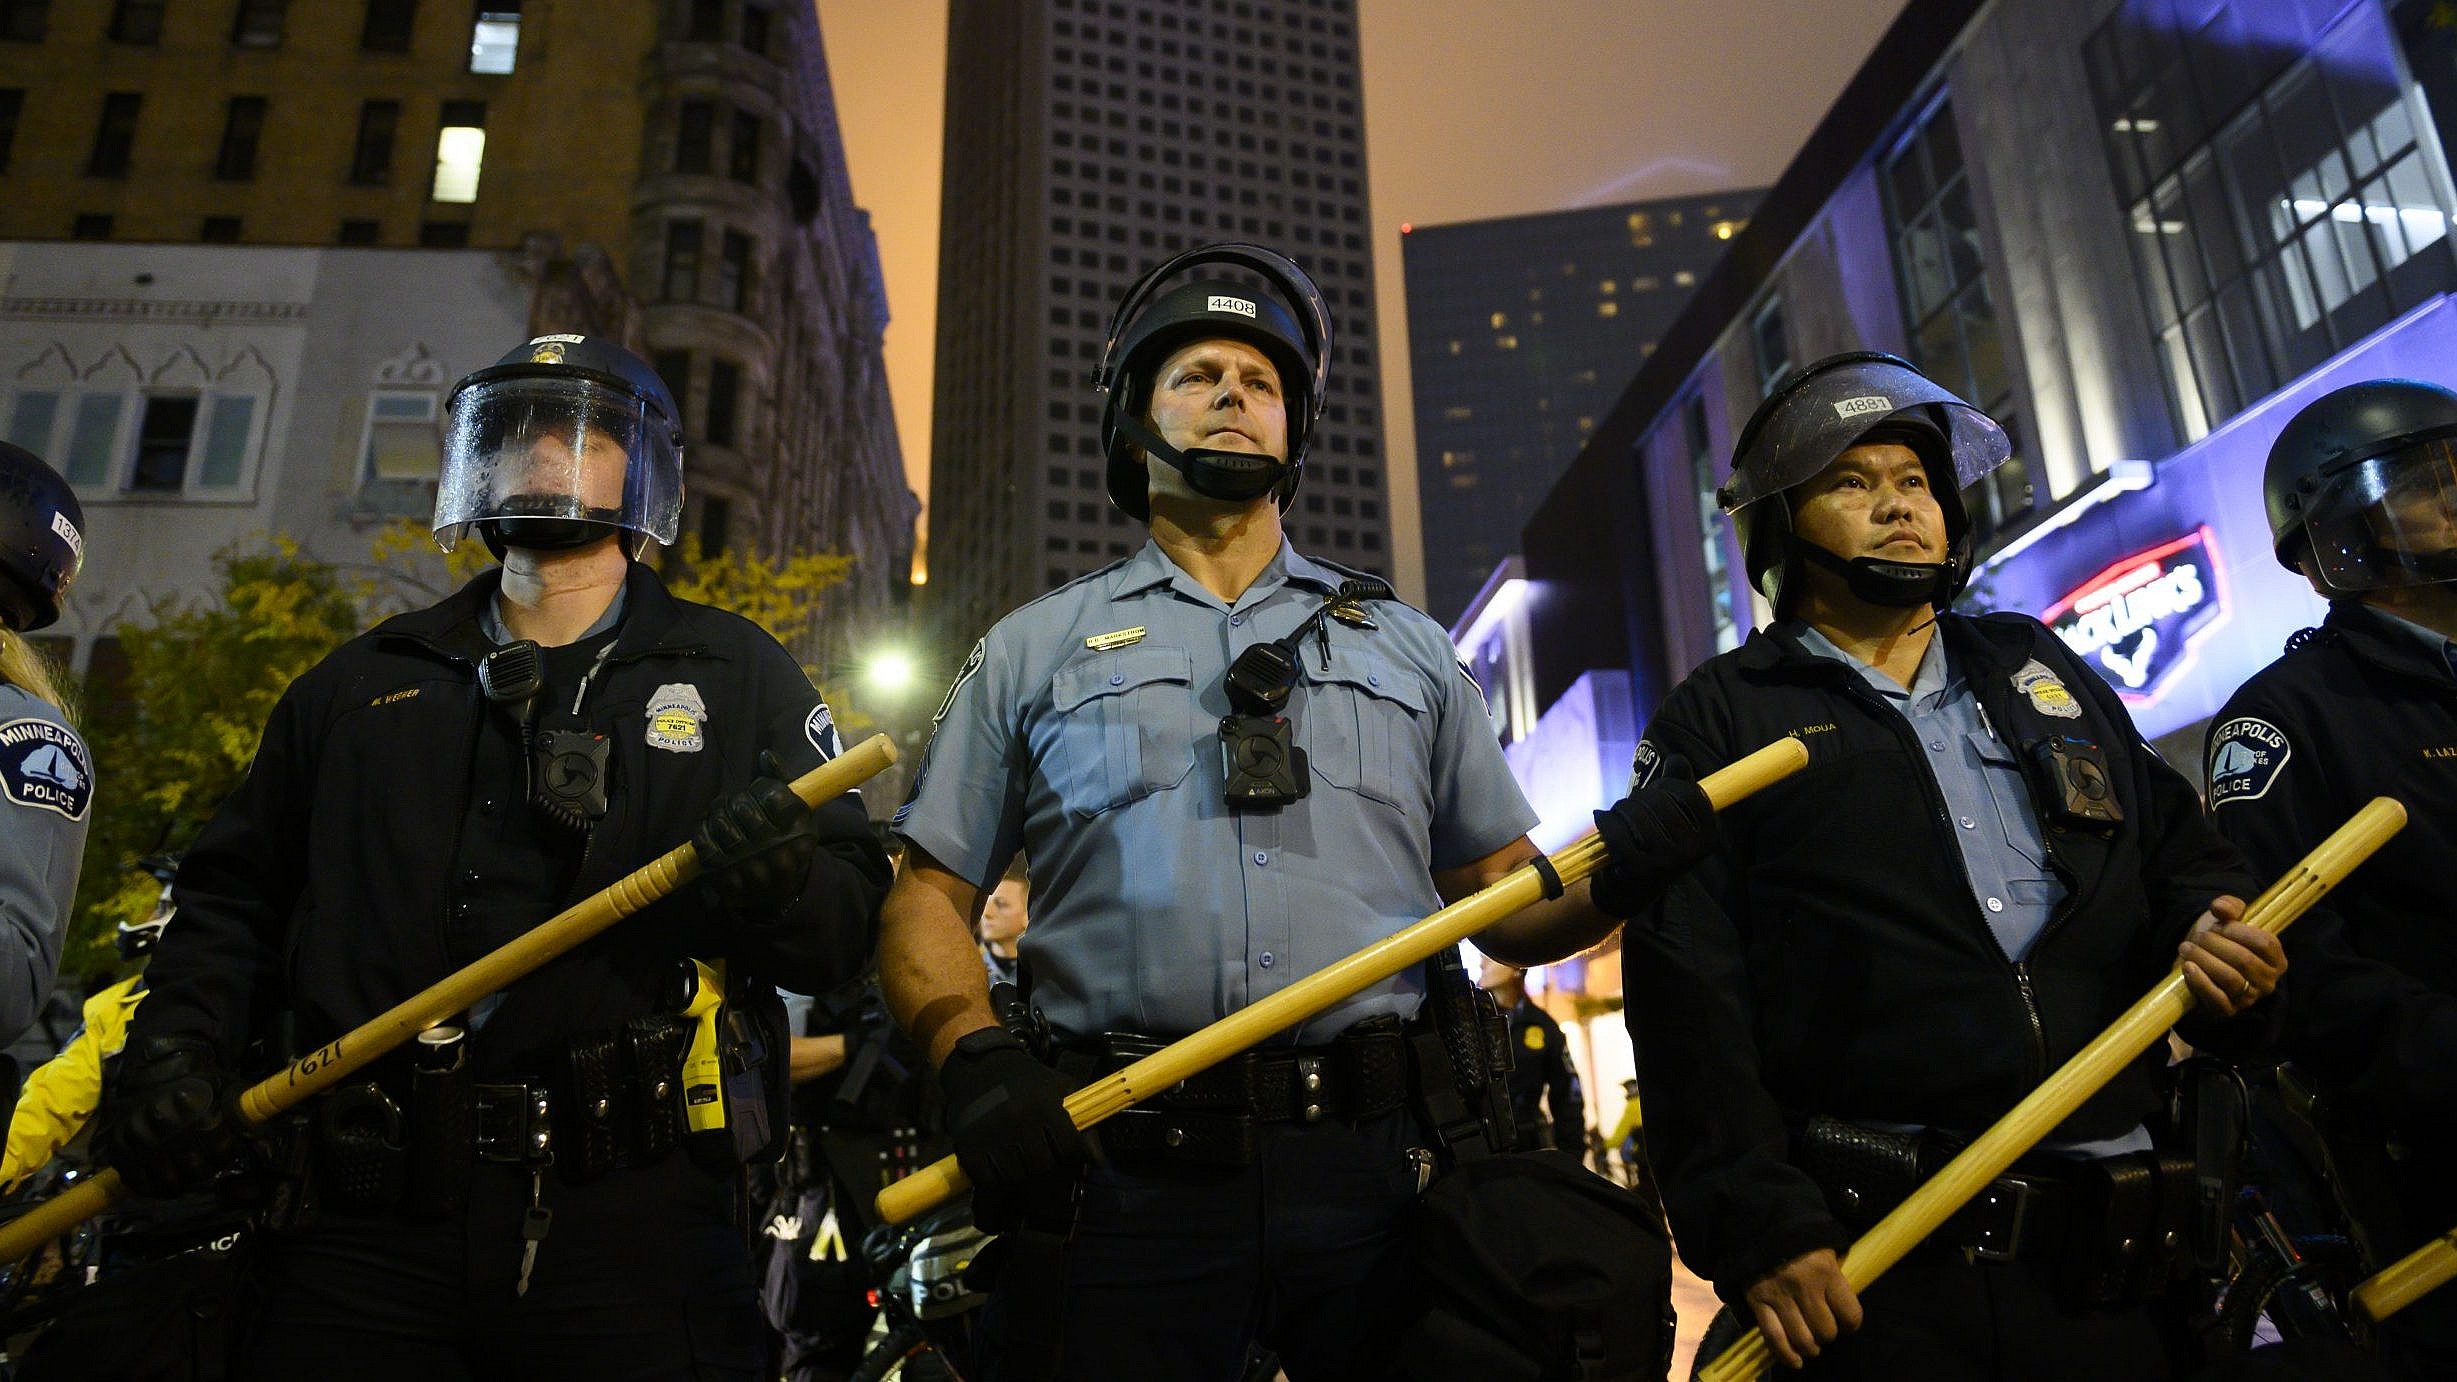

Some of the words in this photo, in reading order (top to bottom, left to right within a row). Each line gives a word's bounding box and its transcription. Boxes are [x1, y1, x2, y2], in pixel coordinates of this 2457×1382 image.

[1211, 298, 1255, 315] 4408
[1845, 398, 1888, 413] 4881
[655, 703, 697, 716] MINNEAPOLIS
[668, 723, 687, 732] 7621
[1803, 723, 1837, 735] MOUA
[658, 736, 694, 746] POLICE
[2212, 778, 2251, 801] POLICE
[22, 782, 75, 812] POLICE
